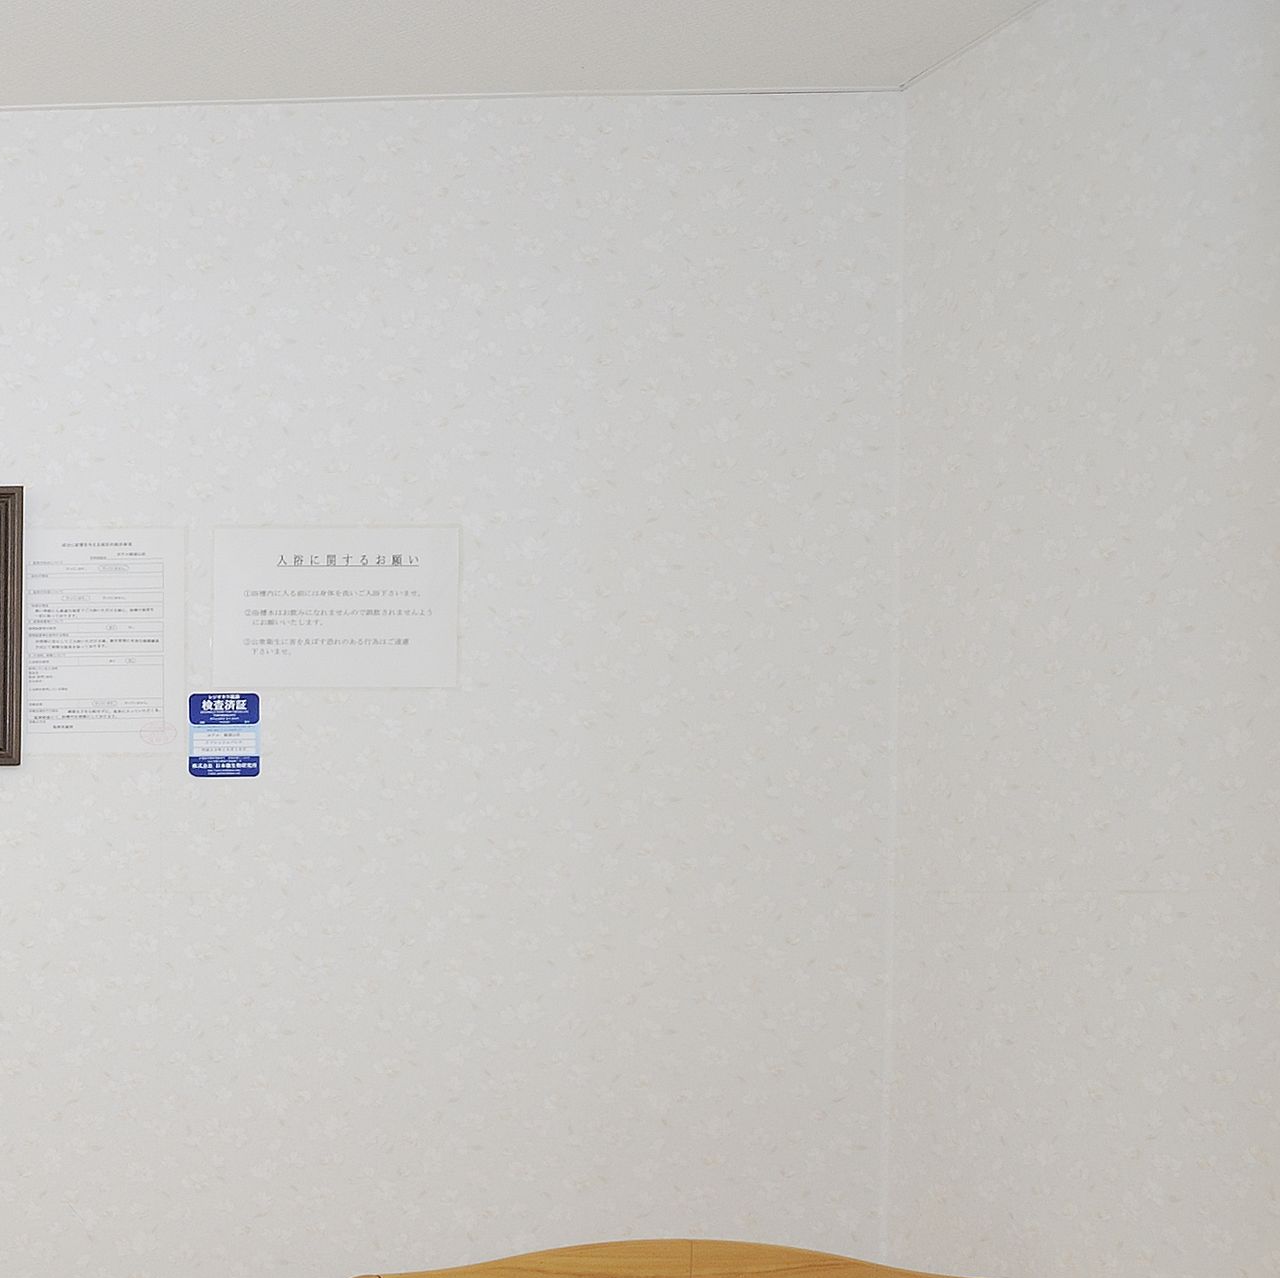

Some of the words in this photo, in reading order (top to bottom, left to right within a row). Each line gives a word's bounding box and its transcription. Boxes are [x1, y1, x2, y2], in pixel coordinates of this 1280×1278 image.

[277, 554, 420, 566] 入浴に関するお願い
[201, 699, 248, 711] 検査済証
